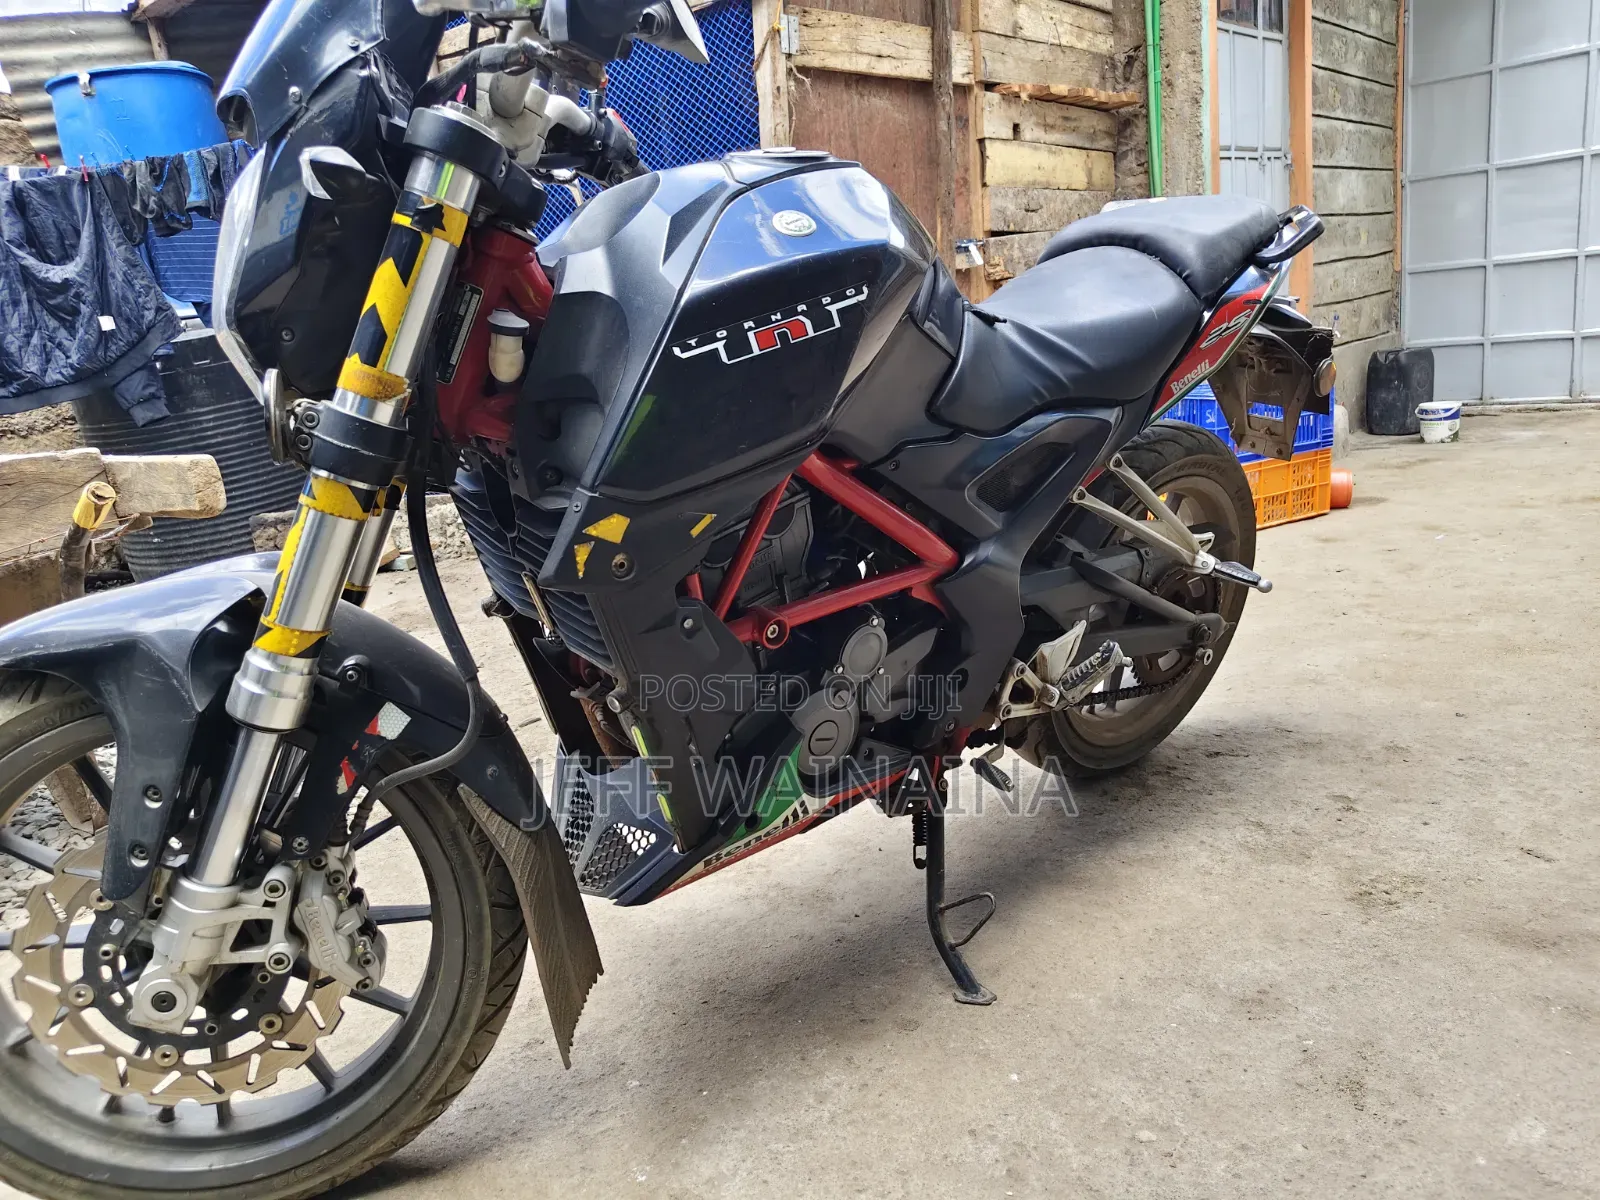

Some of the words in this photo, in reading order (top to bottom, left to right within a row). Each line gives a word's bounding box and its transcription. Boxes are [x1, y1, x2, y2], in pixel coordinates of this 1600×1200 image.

[687, 288, 856, 347] TORNADO
[1170, 359, 1211, 395] Benelli
[702, 800, 811, 870] Benelli
[304, 905, 339, 961] Benelli
